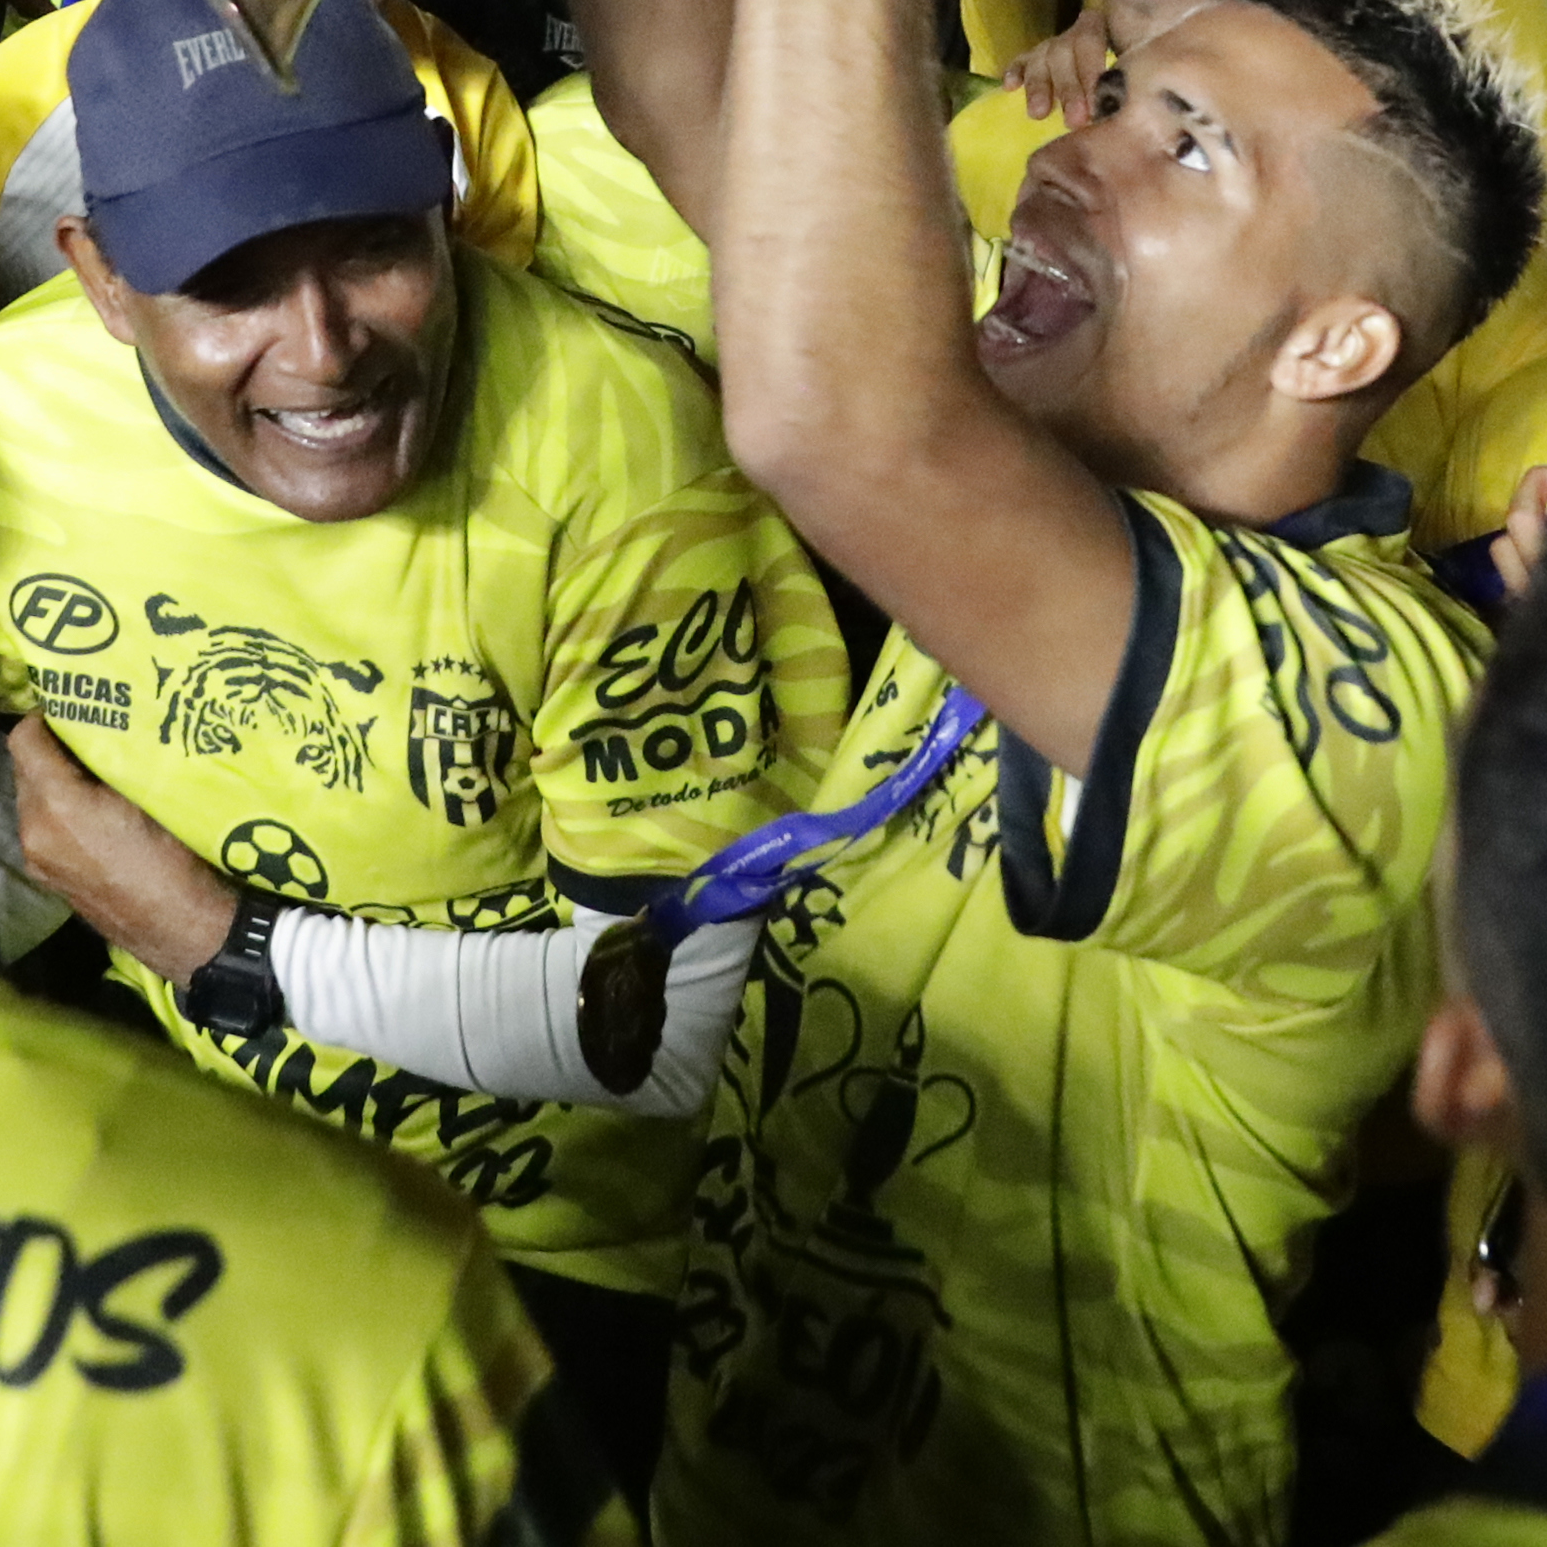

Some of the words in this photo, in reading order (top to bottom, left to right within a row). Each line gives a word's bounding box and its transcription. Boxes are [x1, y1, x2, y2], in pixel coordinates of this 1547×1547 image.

[172, 27, 248, 90] EVERL
[18, 585, 103, 649] FP
[27, 664, 132, 708] BRICAS
[33, 687, 130, 732] CIONALES
[433, 706, 492, 738] CAI
[582, 683, 780, 784] MODA
[650, 781, 703, 808] todo
